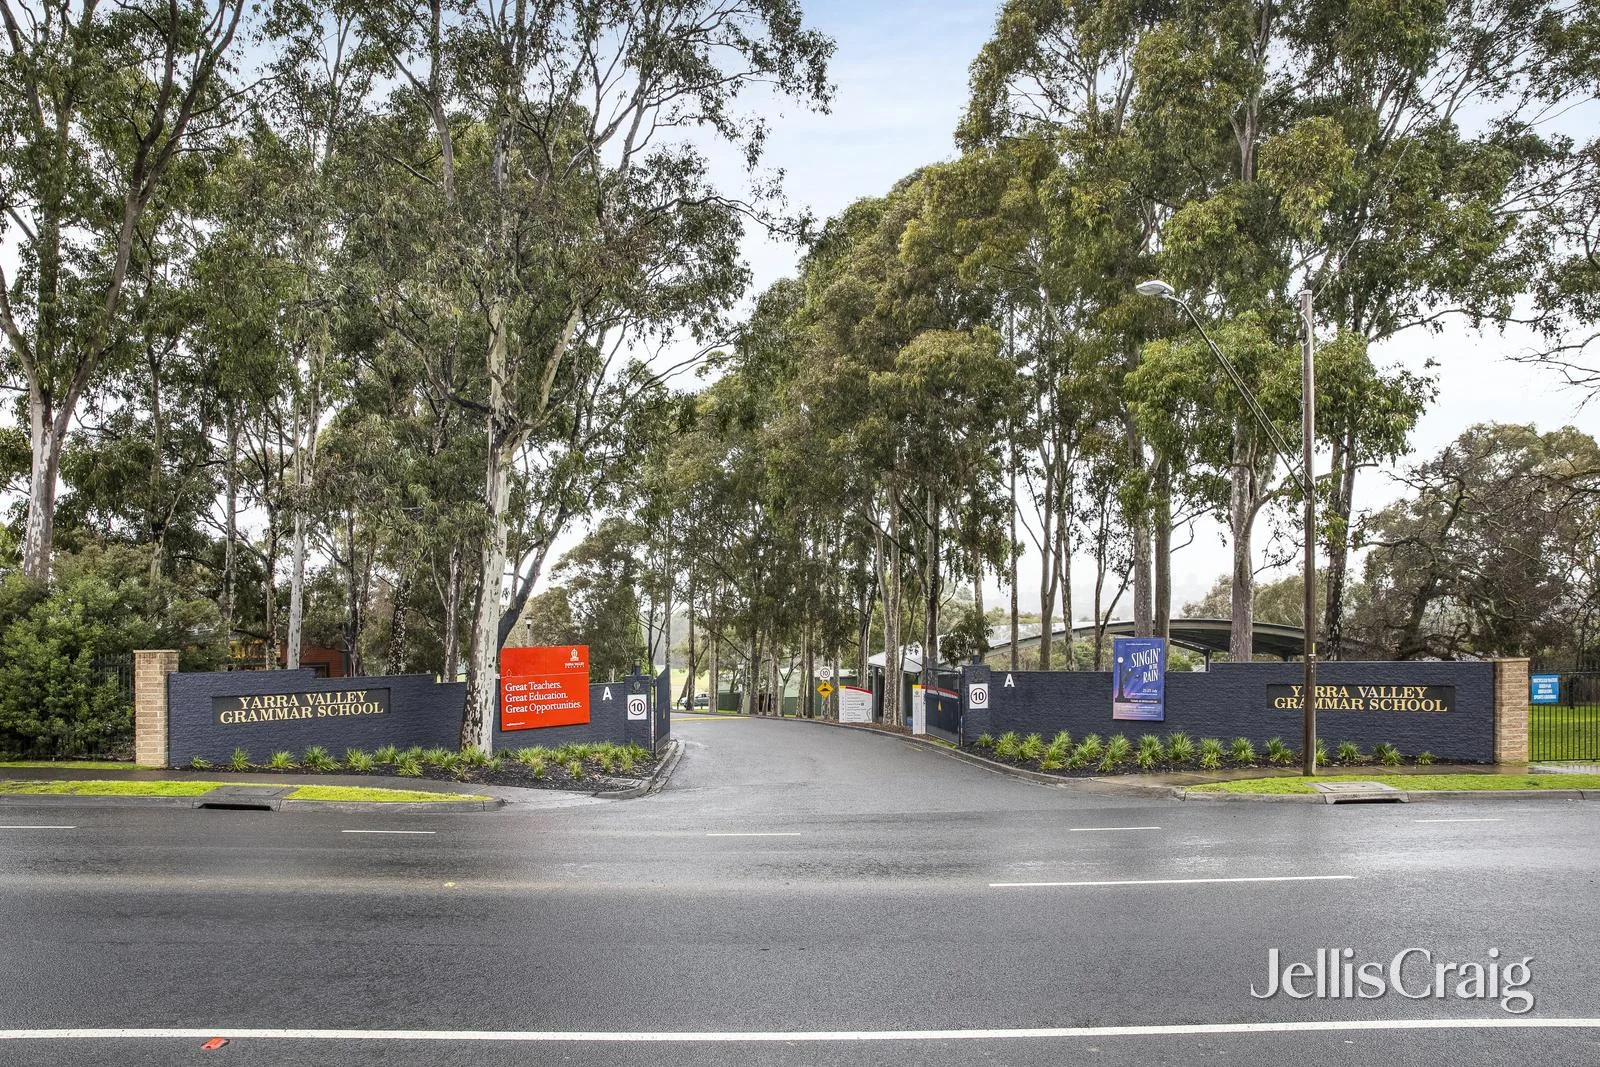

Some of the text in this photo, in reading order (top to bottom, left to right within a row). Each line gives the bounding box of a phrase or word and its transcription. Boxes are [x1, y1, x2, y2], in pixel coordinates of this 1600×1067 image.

[1131, 648, 1161, 668] SINGIN'
[1004, 674, 1015, 688] A
[1143, 670, 1158, 684] RAIN
[506, 680, 562, 692] Great Teachers.
[602, 686, 612, 700] A
[1291, 686, 1428, 698] YRRA VALLEY
[239, 691, 367, 710] YARRA VALLEY
[506, 691, 568, 702] Great Education.
[973, 692, 984, 701] 10
[506, 702, 582, 714] Great Opportunities.
[631, 702, 643, 712] 10
[1369, 698, 1448, 712] SCHOOL
[220, 702, 384, 724] GRAMMAR SCHOOL
